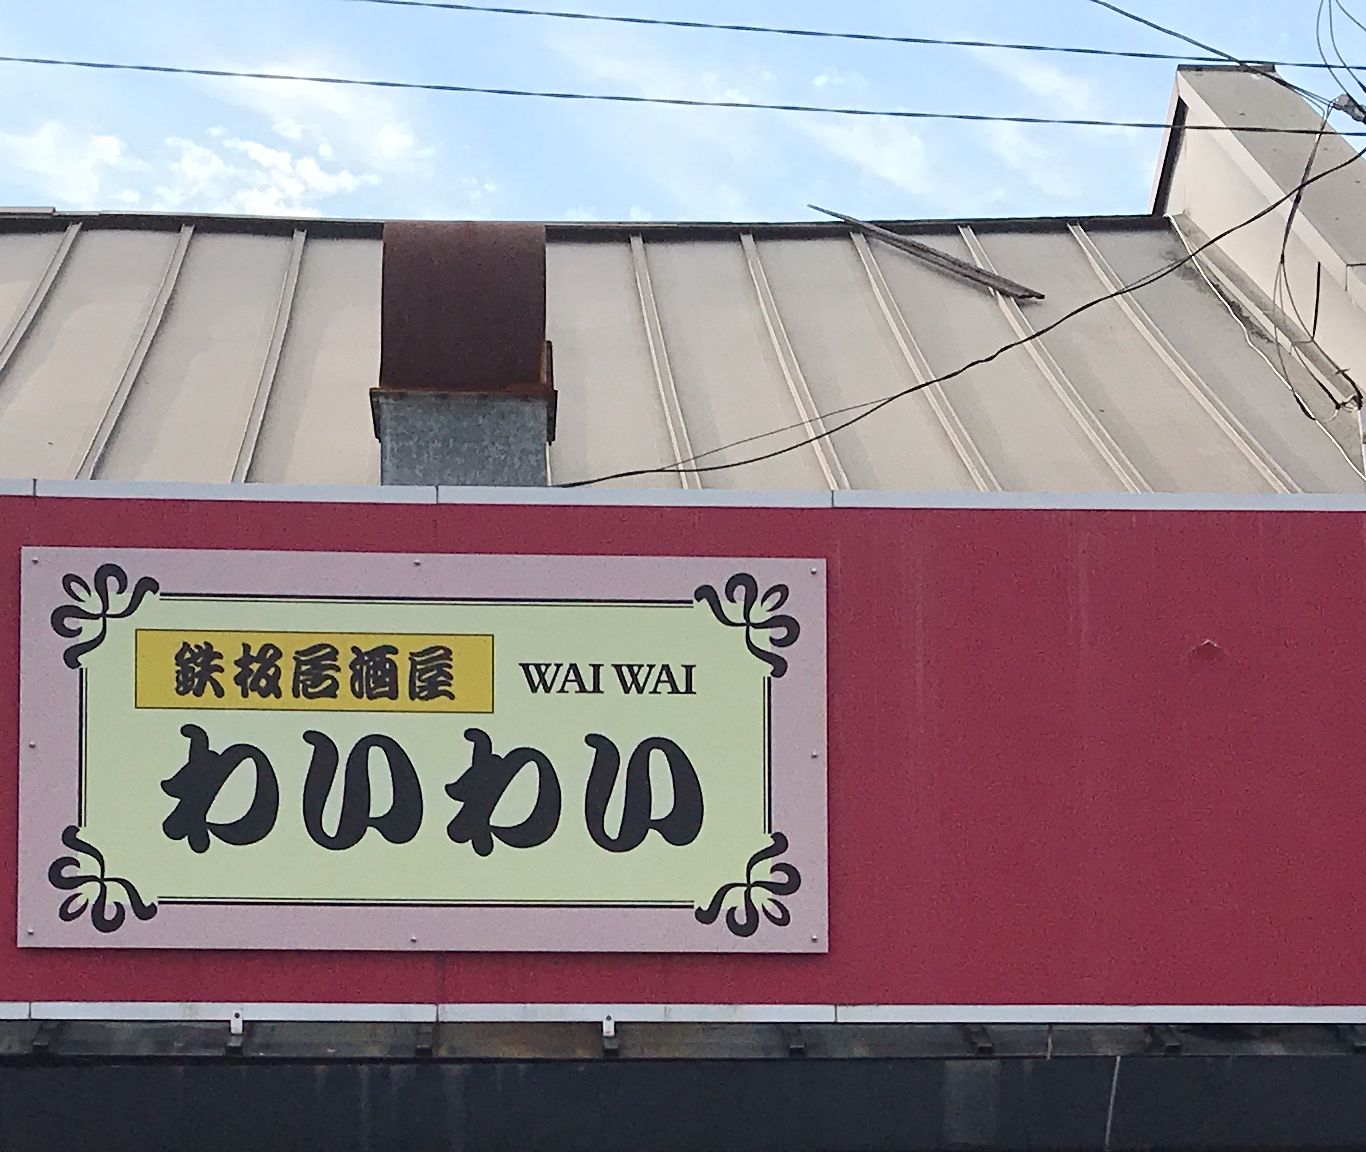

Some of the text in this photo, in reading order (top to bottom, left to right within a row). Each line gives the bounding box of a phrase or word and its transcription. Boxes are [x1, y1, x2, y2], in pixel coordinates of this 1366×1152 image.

[172, 641, 458, 702] 鉄板居酒屋
[519, 662, 697, 696] WAI WAI
[160, 723, 705, 857] わいわい
